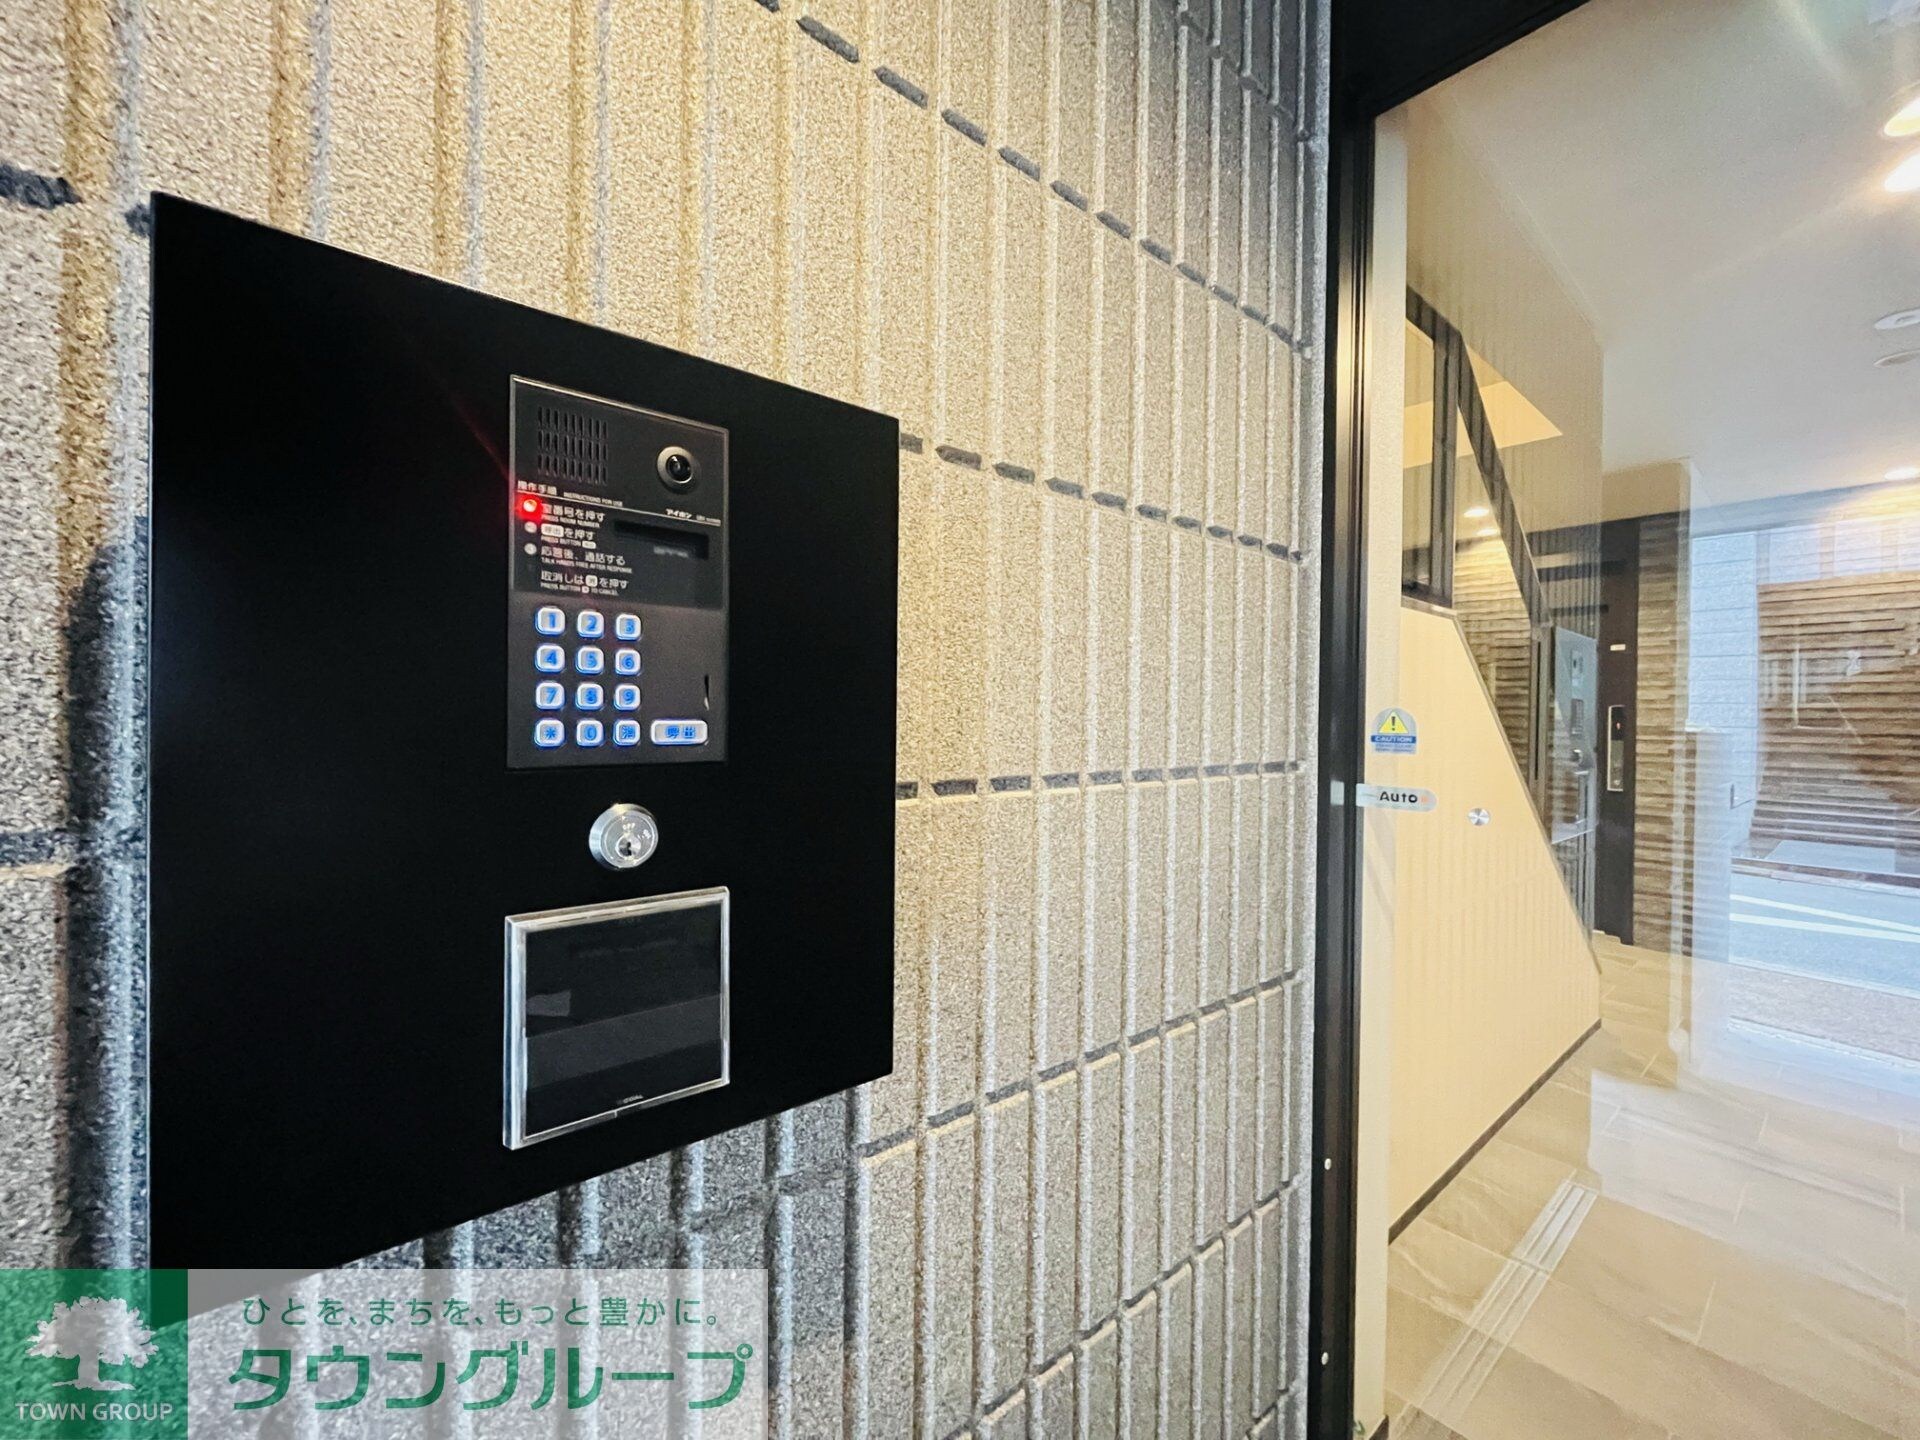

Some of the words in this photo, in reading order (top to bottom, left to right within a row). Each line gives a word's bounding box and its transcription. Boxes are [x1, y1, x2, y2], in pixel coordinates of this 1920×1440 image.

[548, 614, 556, 628] 1
[586, 617, 597, 631] 2
[625, 619, 635, 634] 3
[546, 652, 557, 665] 4
[586, 653, 597, 667] 5
[622, 655, 634, 669] 6
[546, 687, 557, 703] 7
[585, 688, 597, 703] 8
[622, 690, 634, 704] 9
[585, 725, 597, 740] 0
[1380, 791, 1418, 803] Auto
